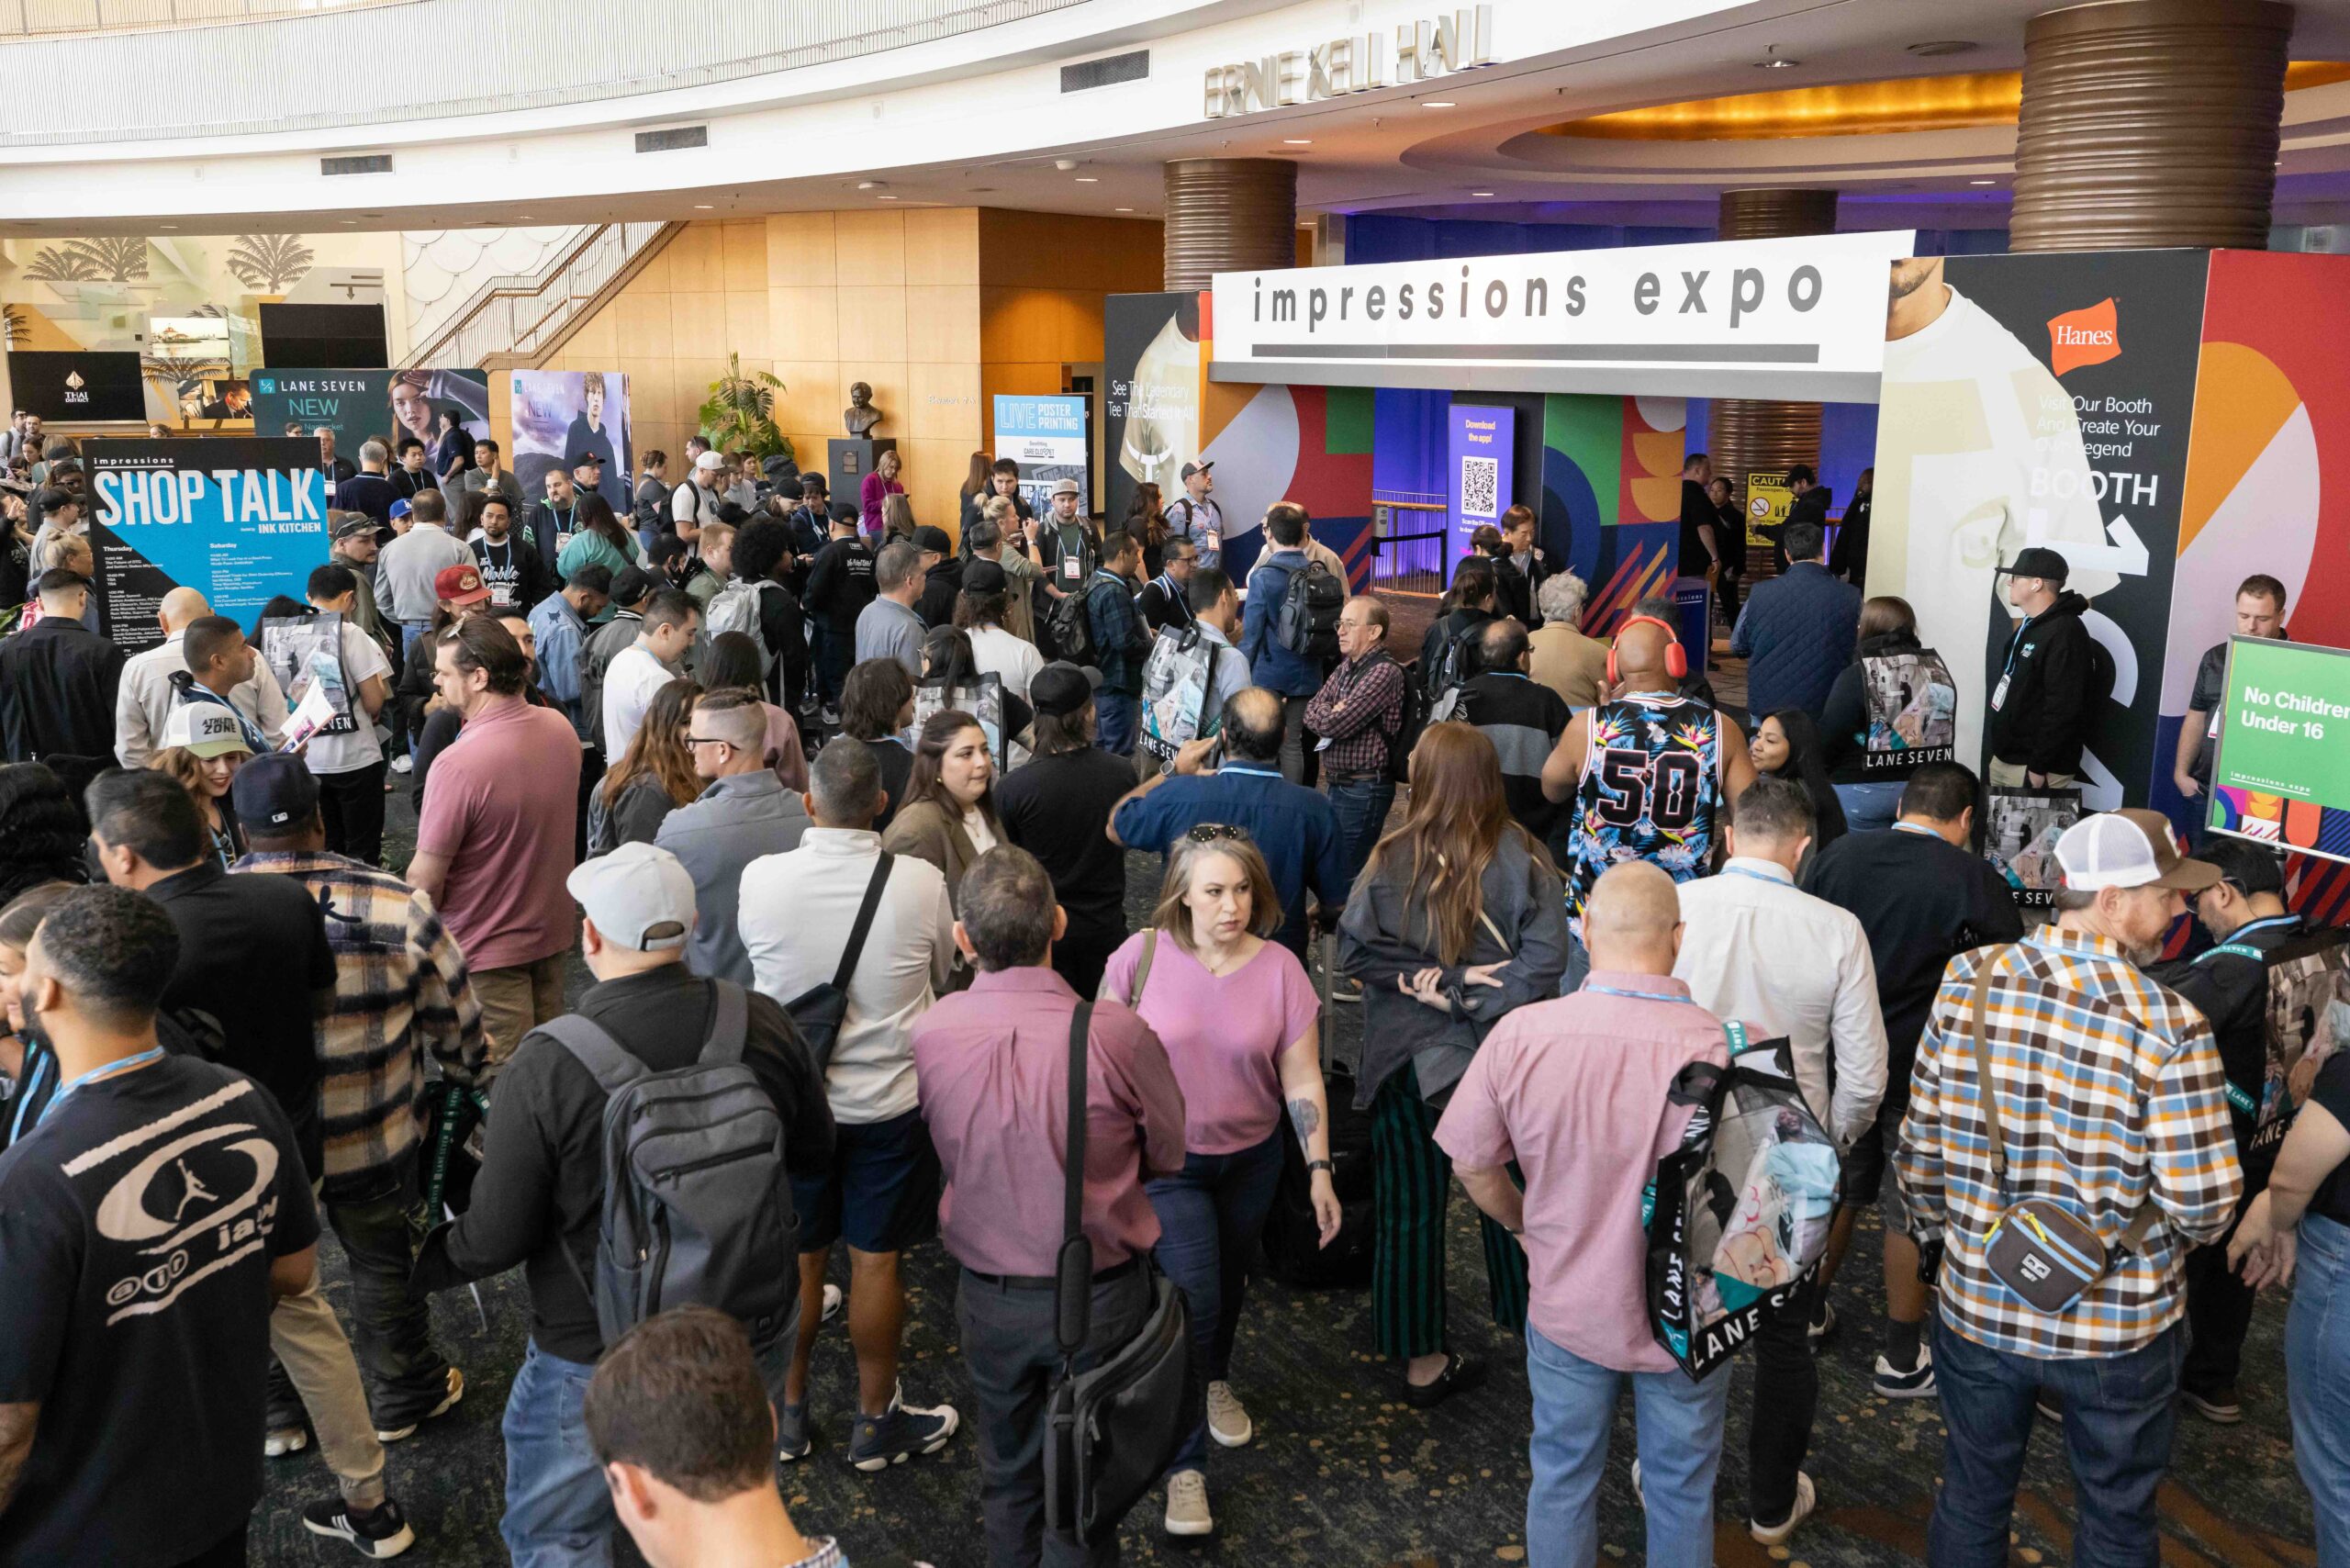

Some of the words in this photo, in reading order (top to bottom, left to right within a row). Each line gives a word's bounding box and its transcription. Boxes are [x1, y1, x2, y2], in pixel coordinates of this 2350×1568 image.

[1396, 4, 1503, 84] HALL
[1252, 264, 1587, 333] impressions
[1632, 263, 1824, 329] expo
[2056, 326, 2113, 345] Hanes
[281, 381, 316, 392] LANE
[322, 380, 365, 392] SEVEN
[1112, 379, 1127, 397] See
[1127, 380, 1144, 398] The
[1146, 381, 1191, 401] Legendary
[288, 398, 340, 416] NEW
[528, 400, 552, 419] NEW
[1038, 403, 1071, 416] POSTER
[1107, 401, 1122, 418] Tee
[1123, 402, 1142, 419] That
[1142, 403, 1175, 420] Started
[2040, 395, 2066, 411] Visit
[2073, 395, 2102, 412] Our
[2105, 397, 2153, 414] Booth
[1000, 402, 1036, 429] LIVE
[1038, 417, 1079, 431] PRINTING
[1465, 420, 1496, 431] Download
[2036, 416, 2066, 434] And
[2071, 417, 2120, 435] Create
[2124, 420, 2161, 437] Your
[1469, 432, 1478, 442] the
[94, 456, 174, 466] impressions
[2031, 466, 2158, 507] BOOTH
[94, 470, 206, 526] SHOP
[211, 467, 321, 522] TALK
[258, 523, 277, 533] INK
[278, 521, 321, 533] KITCHEN
[482, 566, 520, 581] Mobile
[2244, 686, 2270, 706] No
[204, 724, 238, 735] ZONE
[320, 716, 352, 732] EVEN
[2241, 709, 2296, 735] Under
[2301, 722, 2324, 740] 16
[1138, 731, 1158, 752] LANE
[1160, 744, 1179, 762] SEV
[1866, 752, 1903, 768] LANE
[1907, 747, 1953, 764] SEVEN
[1596, 747, 1701, 831] 50
[2230, 770, 2286, 788] impressions
[2288, 783, 2311, 793] expo
[2025, 890, 2053, 905] SEV
[1730, 1028, 1743, 1050] LANE
[1692, 1307, 1761, 1371] LANE
